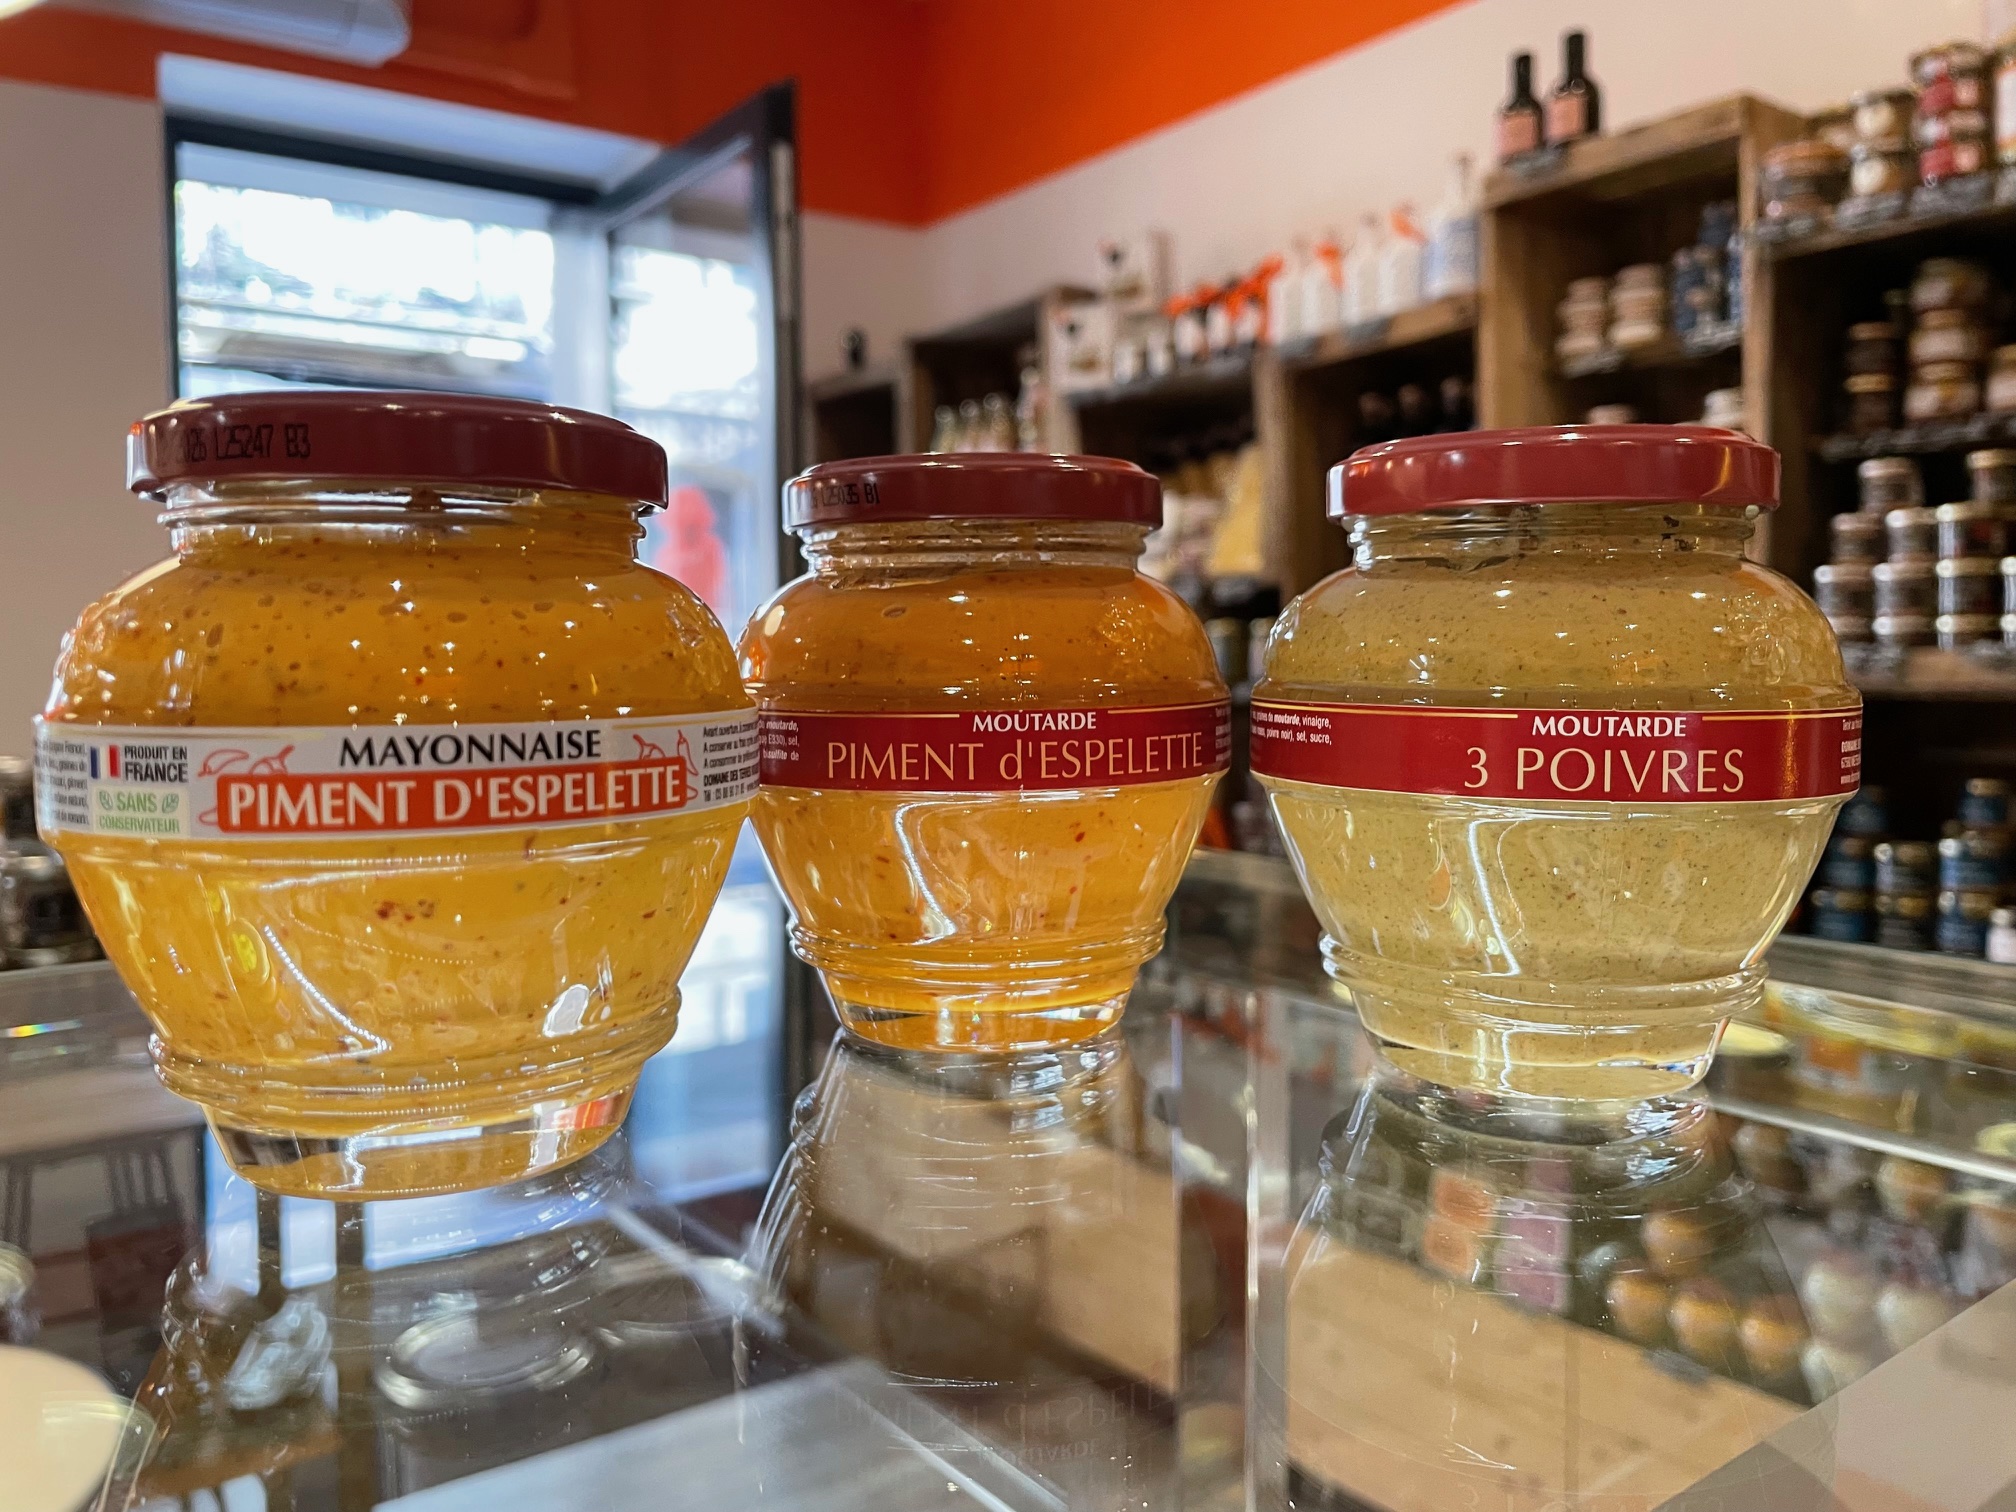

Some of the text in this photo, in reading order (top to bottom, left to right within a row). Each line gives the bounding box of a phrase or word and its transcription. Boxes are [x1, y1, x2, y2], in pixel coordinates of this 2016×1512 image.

[285, 423, 311, 459] B3
[766, 720, 799, 733] moutarde,
[972, 712, 1097, 733] MOUTARDE
[1274, 712, 1301, 727] moutarde,
[1301, 714, 1332, 730] vinaigre,
[1532, 715, 1687, 738] MOUTARDE
[340, 730, 602, 767] MAYONNAISE
[1296, 730, 1308, 743] sel,
[1309, 732, 1332, 746] sucre,
[124, 745, 188, 760] PRODUIT EN
[828, 732, 1203, 781] PIMENT d'ESPELETTE
[124, 762, 189, 783] FRANCE
[1464, 746, 1745, 794] 3 POIVRES
[116, 791, 158, 813] SANS
[229, 765, 681, 827] PIMENT D'ESPELETTE
[99, 815, 180, 833] CONSERVATEUR
